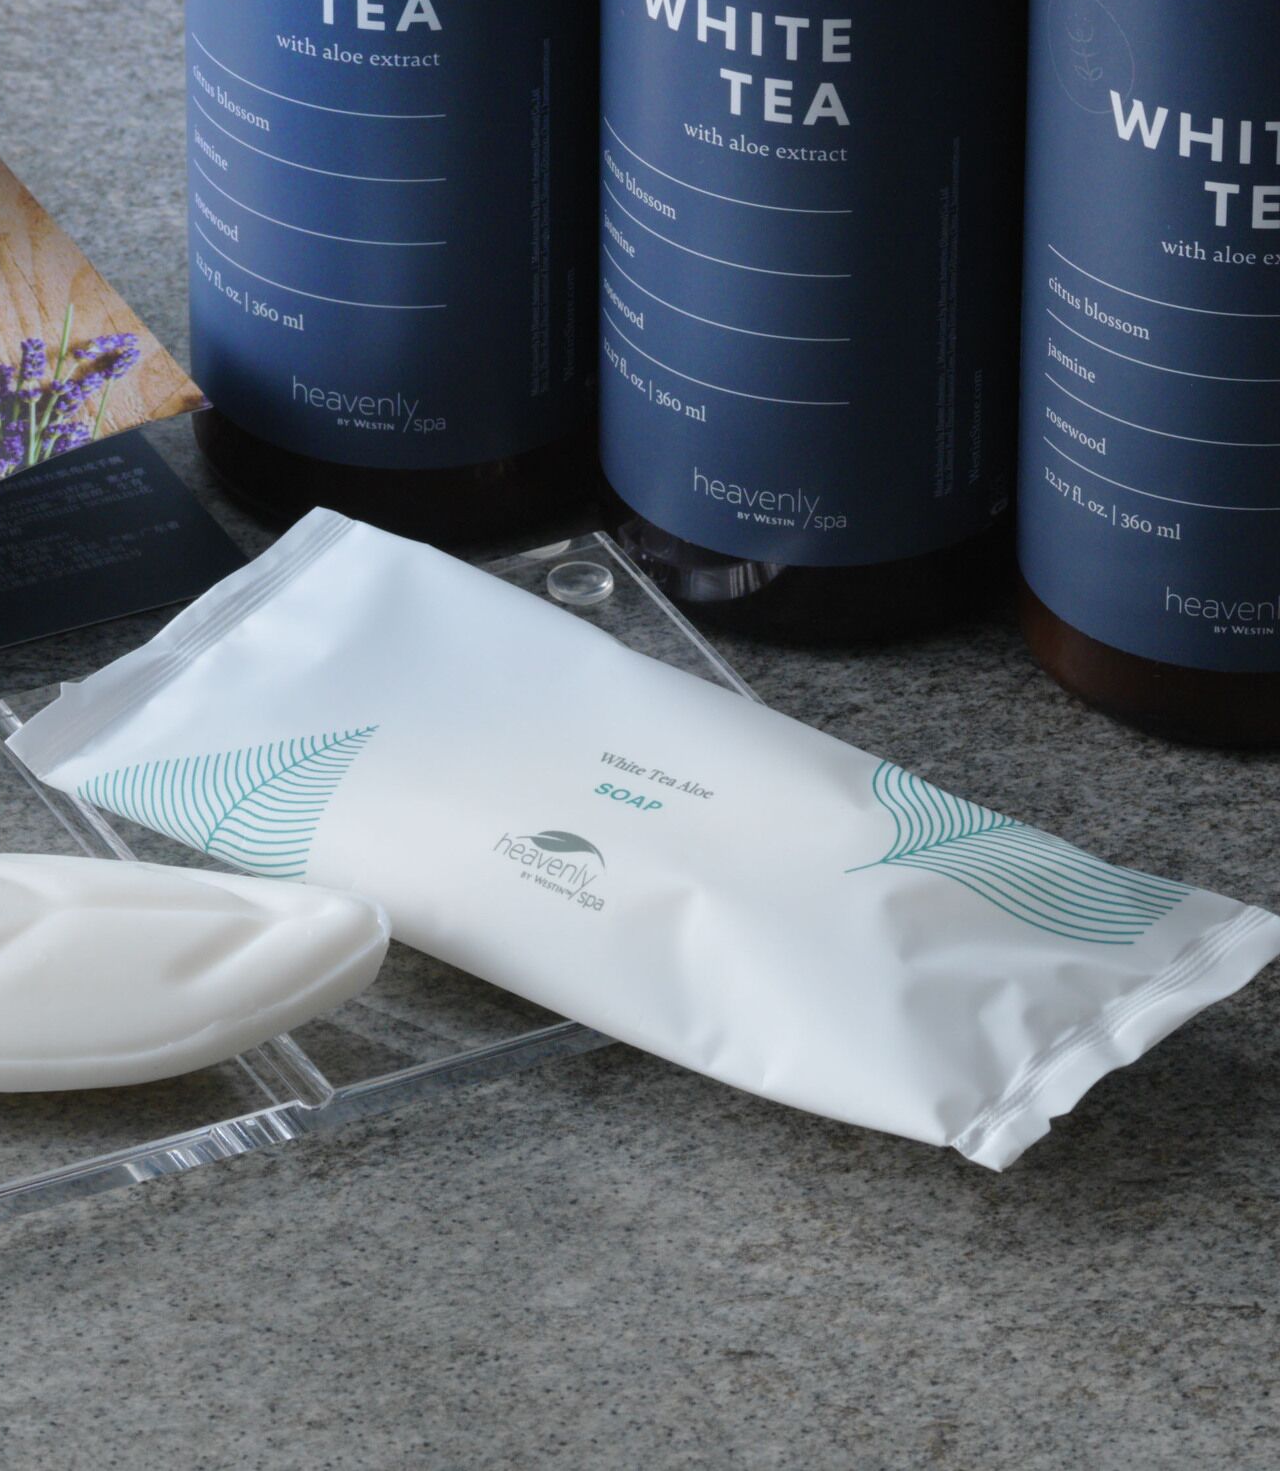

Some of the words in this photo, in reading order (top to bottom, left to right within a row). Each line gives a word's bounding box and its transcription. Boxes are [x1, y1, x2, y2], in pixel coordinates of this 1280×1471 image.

[277, 35, 317, 58] with
[322, 43, 363, 65] aloe
[370, 51, 440, 67] extract
[217, 90, 270, 132] blossom
[720, 67, 850, 126] TEA
[194, 128, 228, 171] jasmine
[684, 123, 723, 147] with
[729, 134, 769, 157] aloe
[776, 145, 848, 163] extract
[625, 171, 677, 220] blossom
[1161, 239, 1206, 261] with
[1213, 245, 1257, 265] aloe
[226, 288, 242, 305] oz.
[252, 300, 279, 322] 360
[283, 314, 305, 331] ml
[1048, 275, 1081, 310] citrus
[1084, 300, 1150, 341] blossom
[1047, 337, 1096, 384] jasmine
[292, 375, 419, 432] heavenly
[631, 374, 646, 393] oz.
[656, 390, 681, 412] 360
[685, 405, 707, 423] ml
[353, 419, 394, 431] WESTIN
[414, 416, 446, 434] spa
[1045, 406, 1106, 456] rosewood
[694, 467, 820, 529] heavenly
[753, 512, 794, 527] WESTIN
[1044, 466, 1070, 498] 12.17
[1072, 484, 1085, 507] fl.
[1088, 499, 1108, 519] oz.
[1120, 512, 1152, 535] 360
[1157, 522, 1181, 540] ml
[815, 512, 847, 531] spa
[1231, 625, 1274, 636] WESTIN
[594, 783, 663, 811] SOAP
[600, 752, 647, 776] White
[648, 769, 676, 787] Tea
[677, 780, 714, 800] Aloe
[493, 832, 597, 900] heavenly
[520, 871, 532, 880] BY
[577, 891, 605, 911] spa
